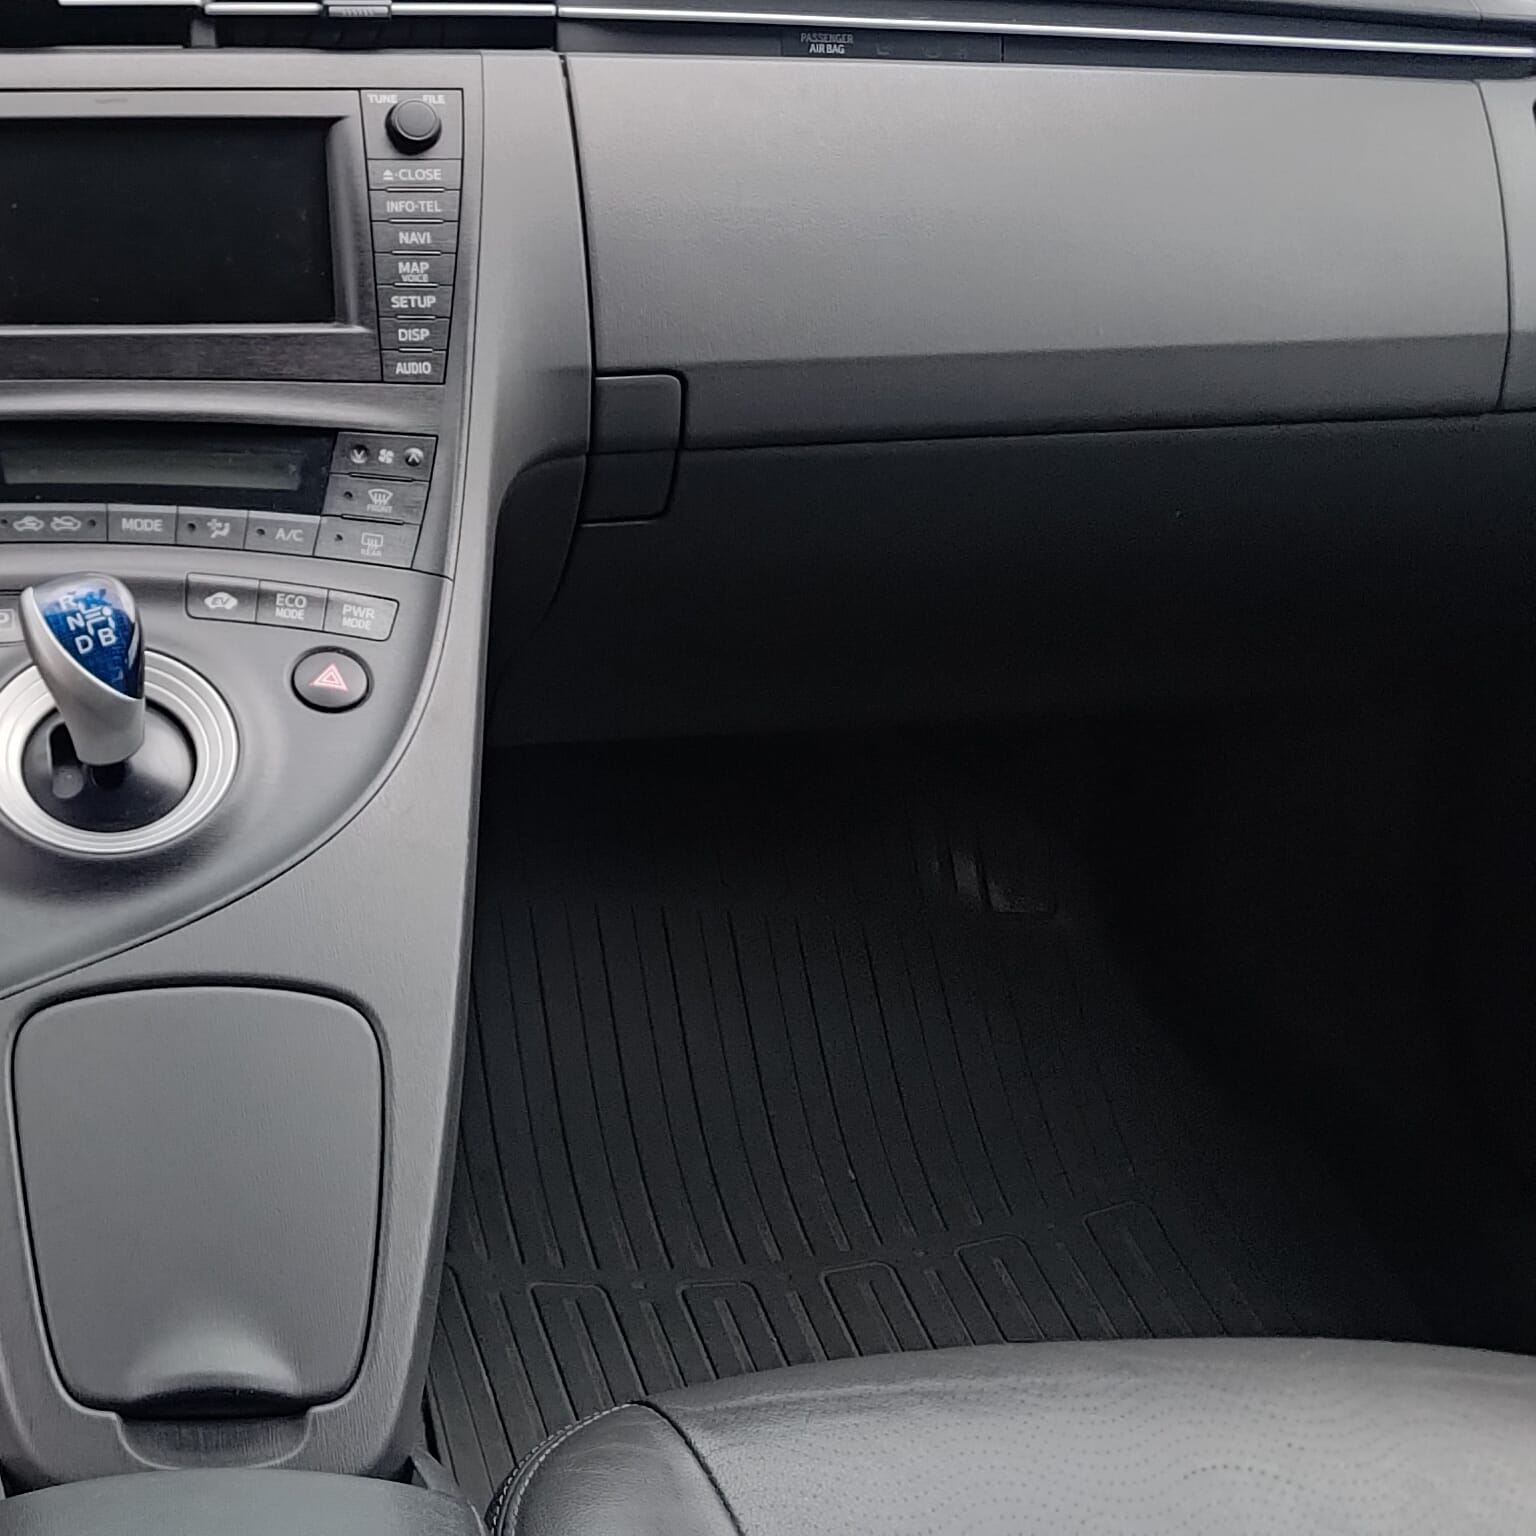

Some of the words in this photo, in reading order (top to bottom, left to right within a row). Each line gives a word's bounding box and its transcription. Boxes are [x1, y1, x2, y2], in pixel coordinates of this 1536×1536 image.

[800, 32, 854, 44] PASSENGER
[367, 94, 398, 104] TUNE
[398, 231, 432, 245] NAVI
[397, 261, 431, 275] MAP
[390, 295, 437, 308] SETUP
[397, 328, 430, 342] DISP
[395, 361, 432, 375] AUDIO
[121, 517, 163, 533] MODE
[275, 527, 304, 543] A/C
[275, 592, 307, 609] ECO
[275, 607, 305, 621] MODE
[342, 603, 376, 620] PWR
[66, 613, 86, 631] N
[341, 616, 372, 631] MODE
[97, 627, 117, 647] B
[75, 635, 94, 654] D
